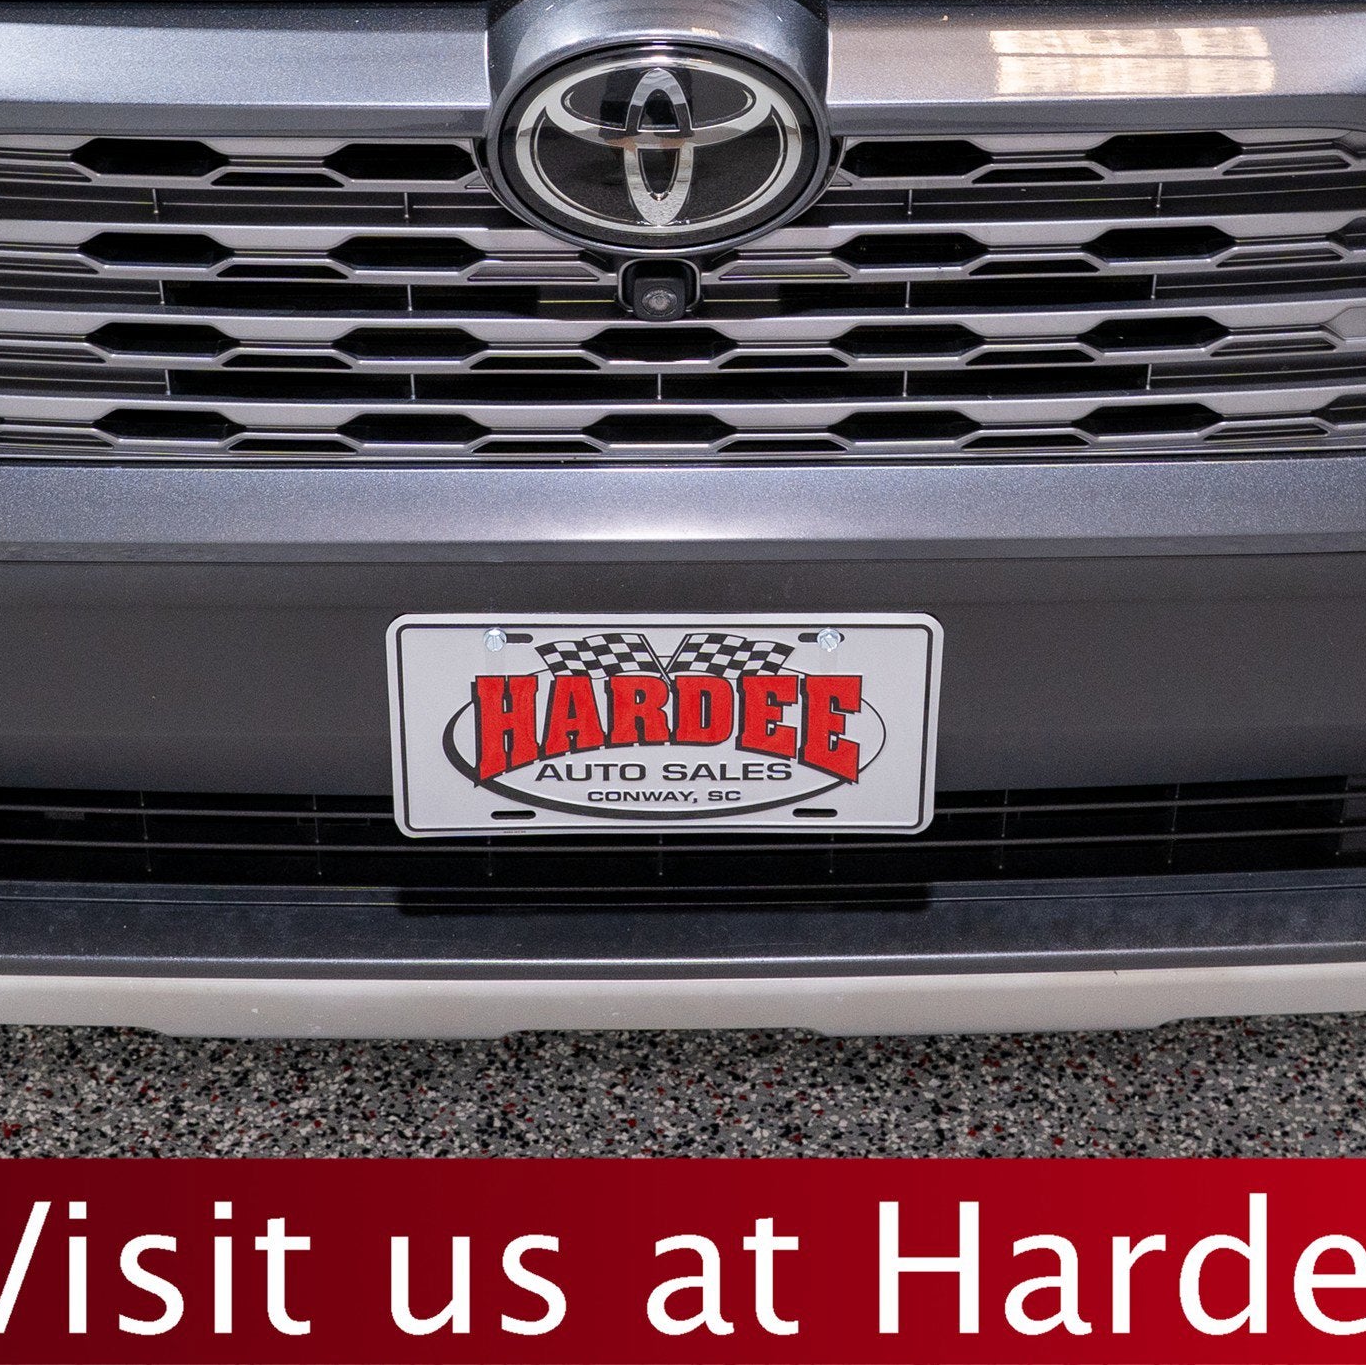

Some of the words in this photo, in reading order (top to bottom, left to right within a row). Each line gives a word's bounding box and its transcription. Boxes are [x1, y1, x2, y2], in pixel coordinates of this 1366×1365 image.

[472, 675, 863, 787] HARDEE
[535, 762, 649, 783] AUTO
[661, 762, 793, 783] SALES
[586, 789, 699, 804] CONWAY,
[707, 789, 742, 803] SC
